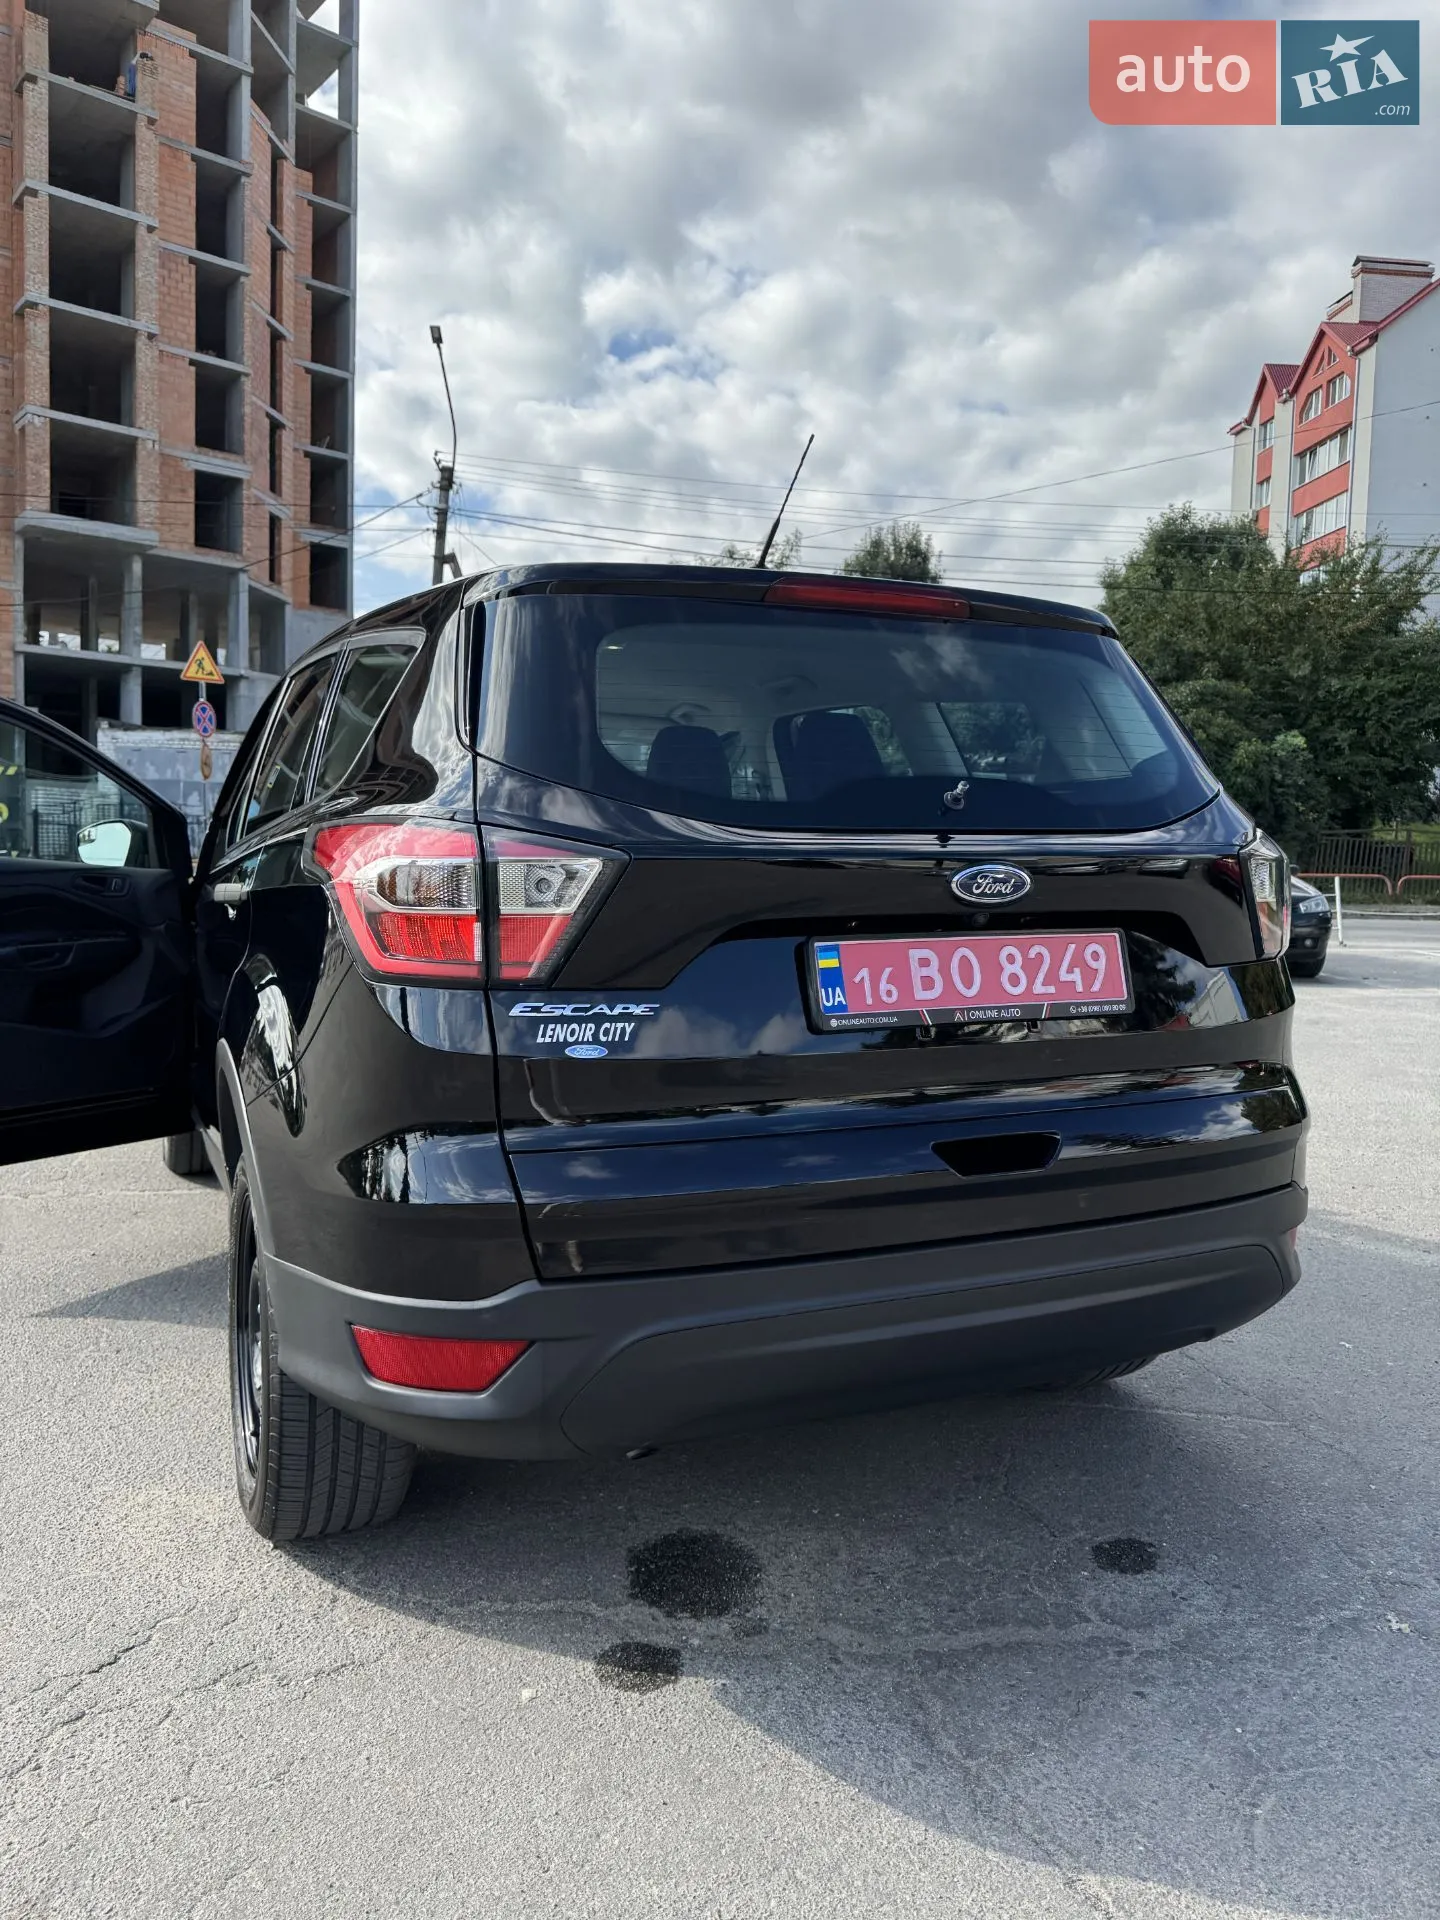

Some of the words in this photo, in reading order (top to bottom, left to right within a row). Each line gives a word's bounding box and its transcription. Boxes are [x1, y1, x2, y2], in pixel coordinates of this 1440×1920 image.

[972, 873, 1016, 894] Ford
[852, 967, 899, 1005] 16
[908, 946, 982, 1000] BO
[999, 942, 1107, 996] 8249
[821, 987, 847, 1007] UA
[508, 1002, 660, 1017] ESCAPE
[969, 1009, 999, 1019] ONLINE
[1000, 1008, 1021, 1017] AUTO
[536, 1023, 595, 1043] LENOIR
[598, 1022, 635, 1042] CITY
[574, 1047, 600, 1056] Ford
